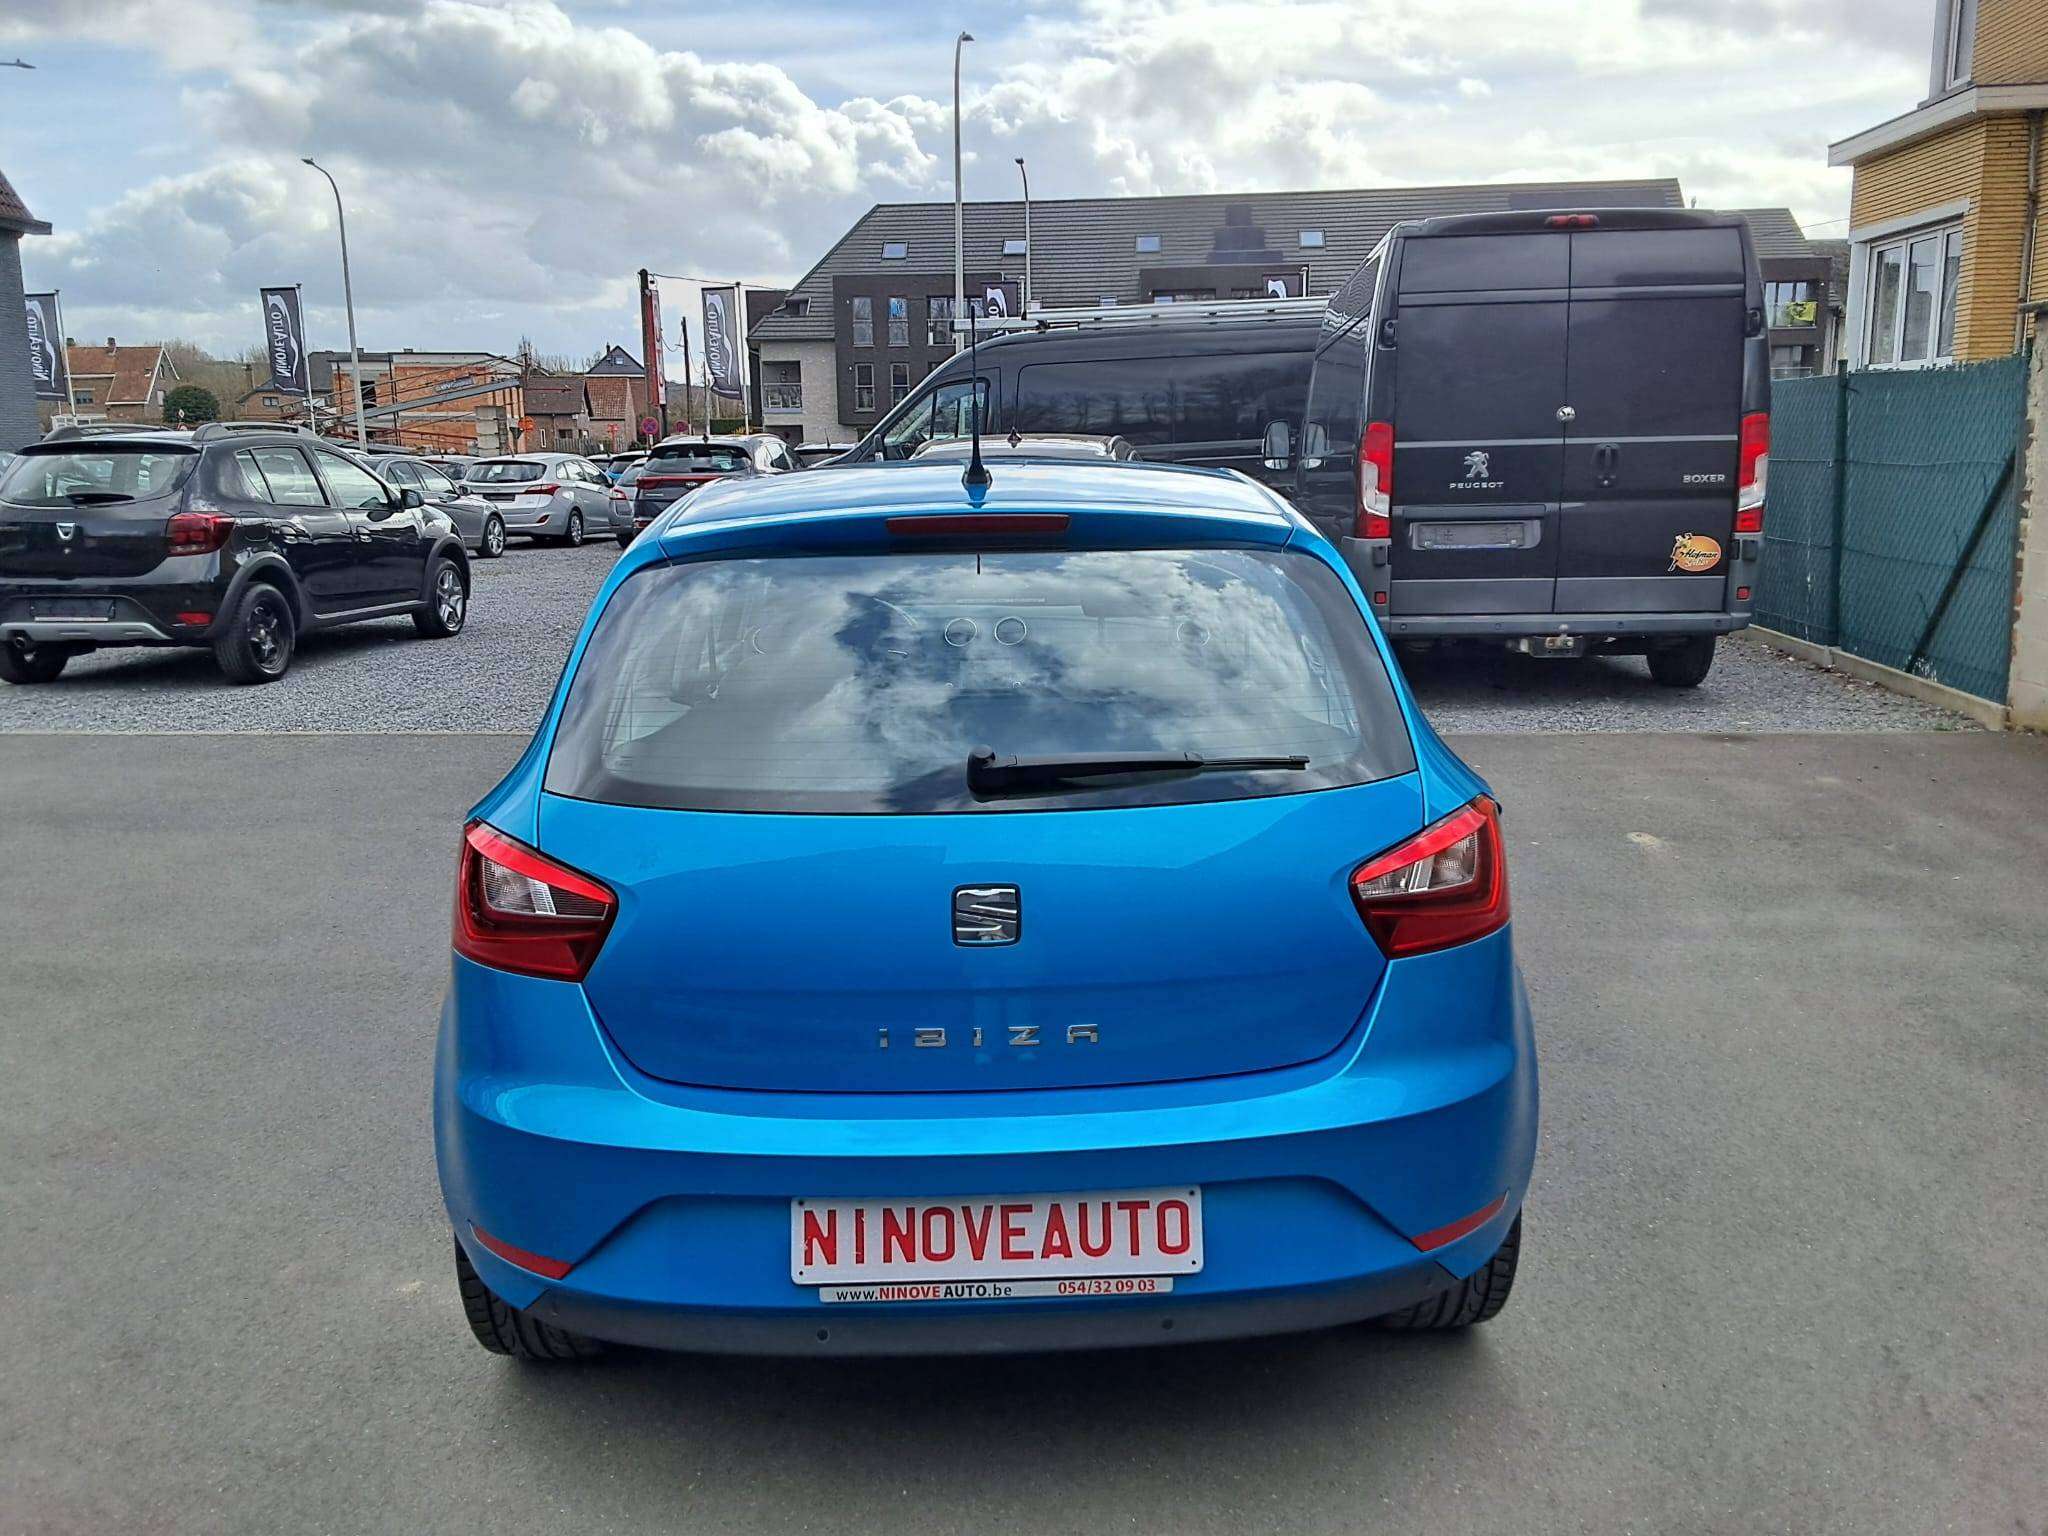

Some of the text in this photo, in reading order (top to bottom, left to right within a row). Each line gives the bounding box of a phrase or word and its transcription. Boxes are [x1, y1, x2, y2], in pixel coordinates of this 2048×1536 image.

[1682, 474, 1726, 483] BOXER
[803, 1199, 1191, 1267] NINOVEAUTO
[1058, 1280, 1112, 1294] 054/32
[1115, 1279, 1134, 1292] 09
[1138, 1279, 1156, 1292] 03
